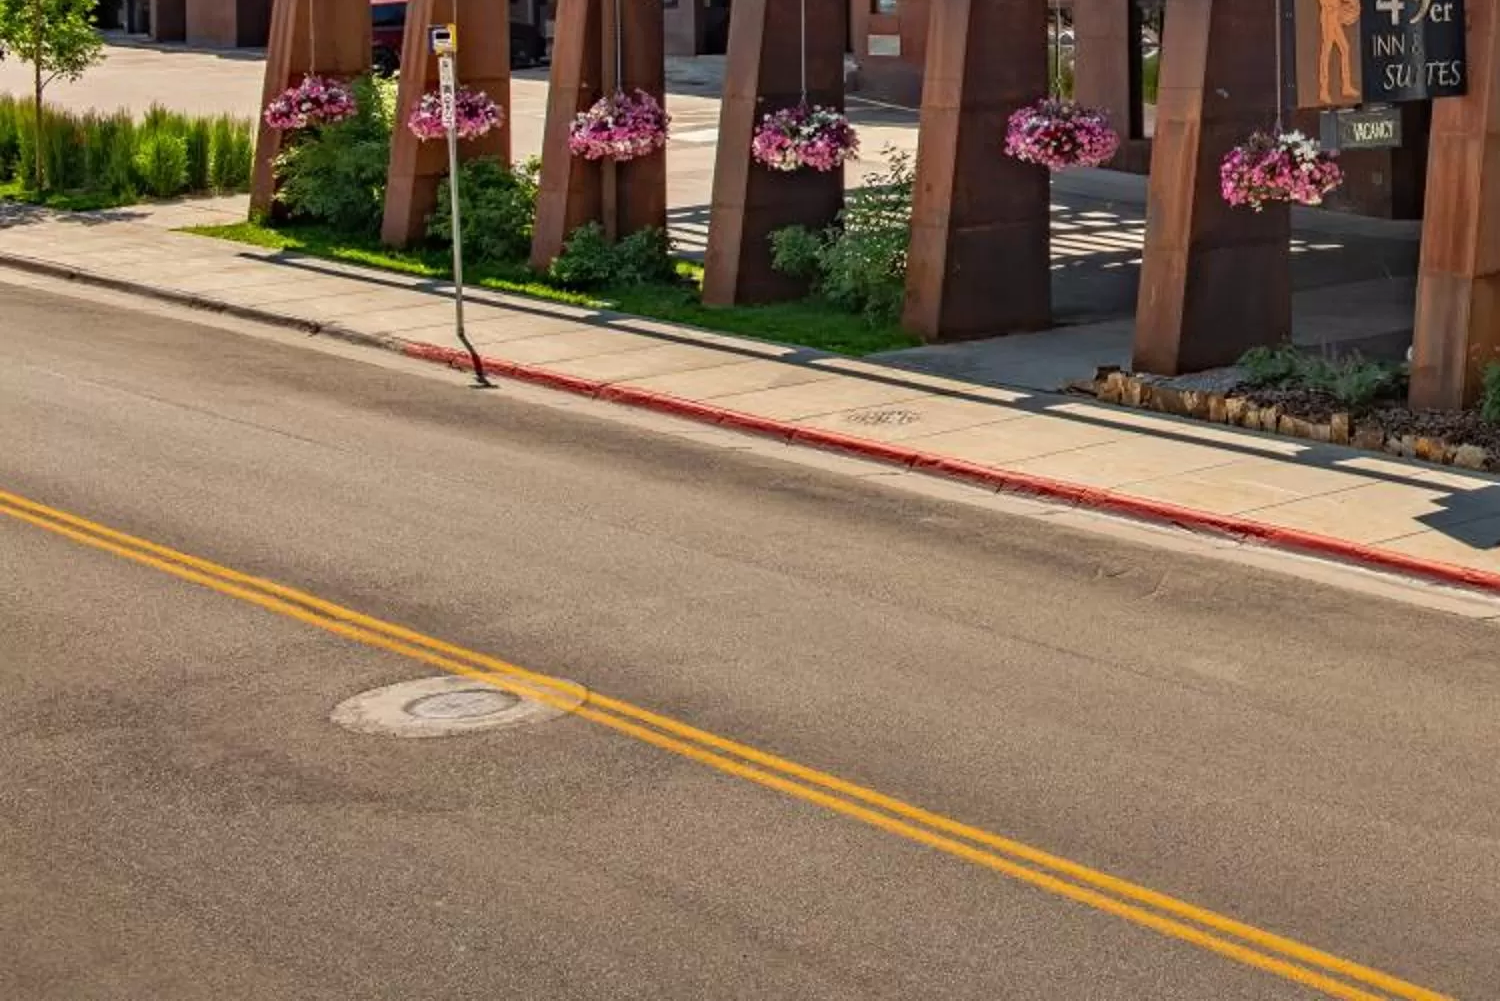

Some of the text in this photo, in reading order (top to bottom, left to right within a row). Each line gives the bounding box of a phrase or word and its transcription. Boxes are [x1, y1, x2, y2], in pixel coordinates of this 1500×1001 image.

[1372, 33, 1423, 56] INN &
[1383, 60, 1461, 90] SUTES
